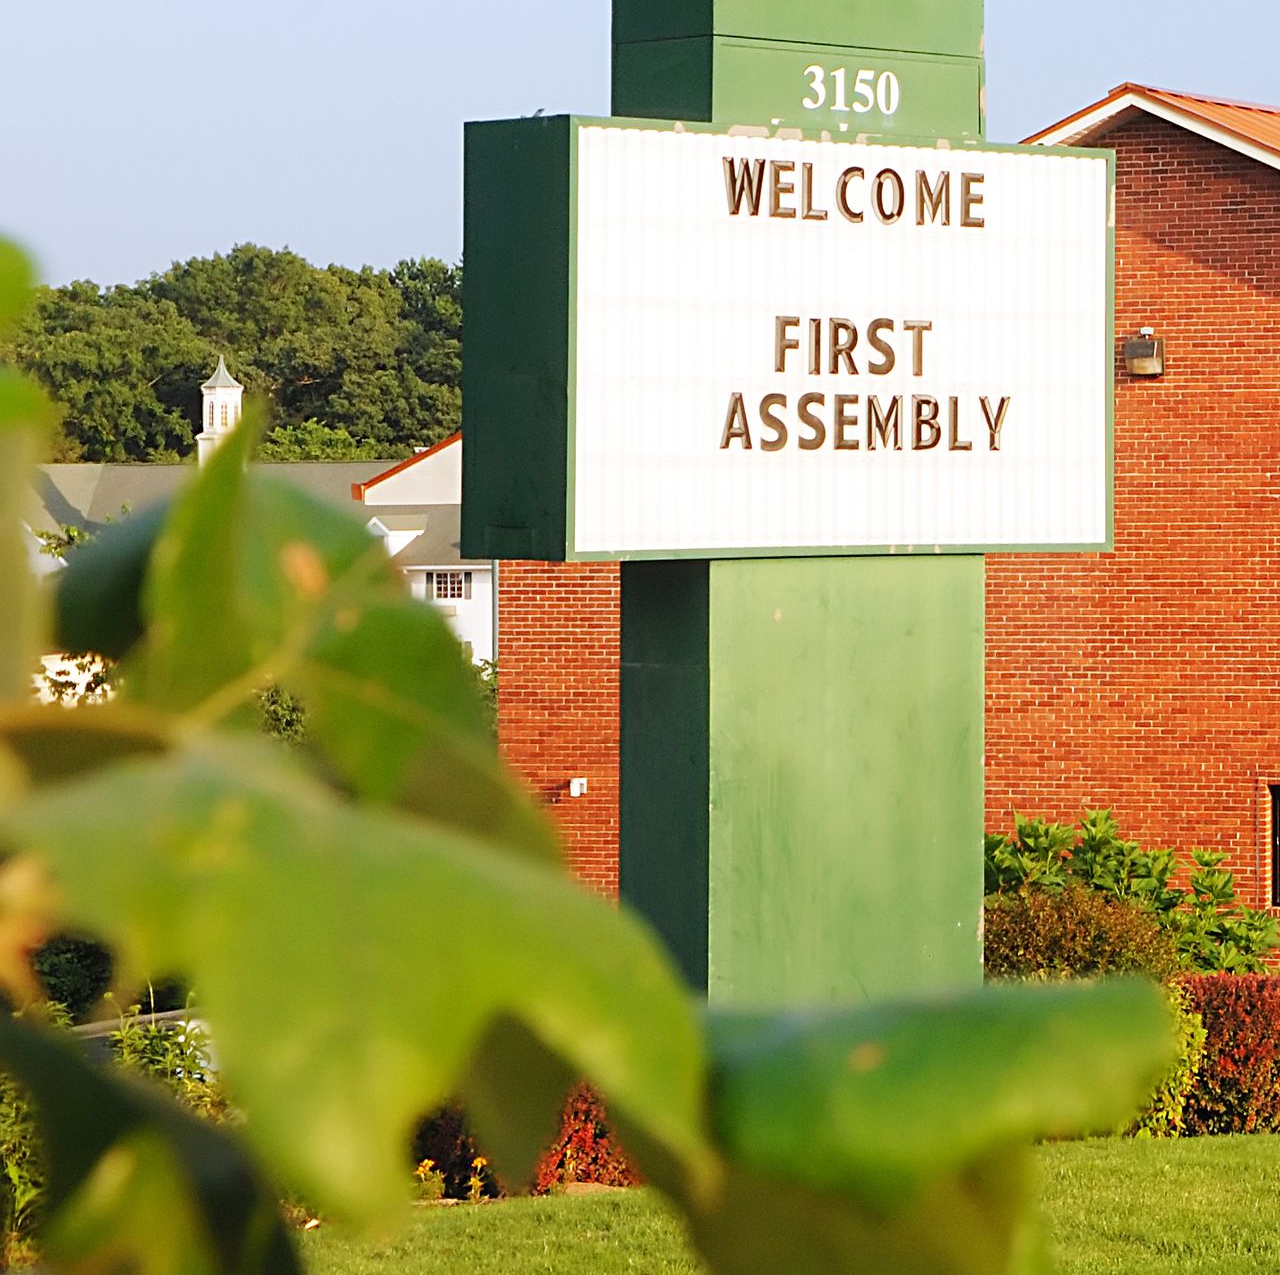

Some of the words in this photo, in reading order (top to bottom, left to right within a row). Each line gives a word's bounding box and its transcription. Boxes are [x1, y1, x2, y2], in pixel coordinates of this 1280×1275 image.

[802, 65, 900, 115] 3150
[721, 156, 985, 227] WELCOME
[774, 315, 933, 376] FIRST
[719, 392, 1011, 451] ASSEMBLY
